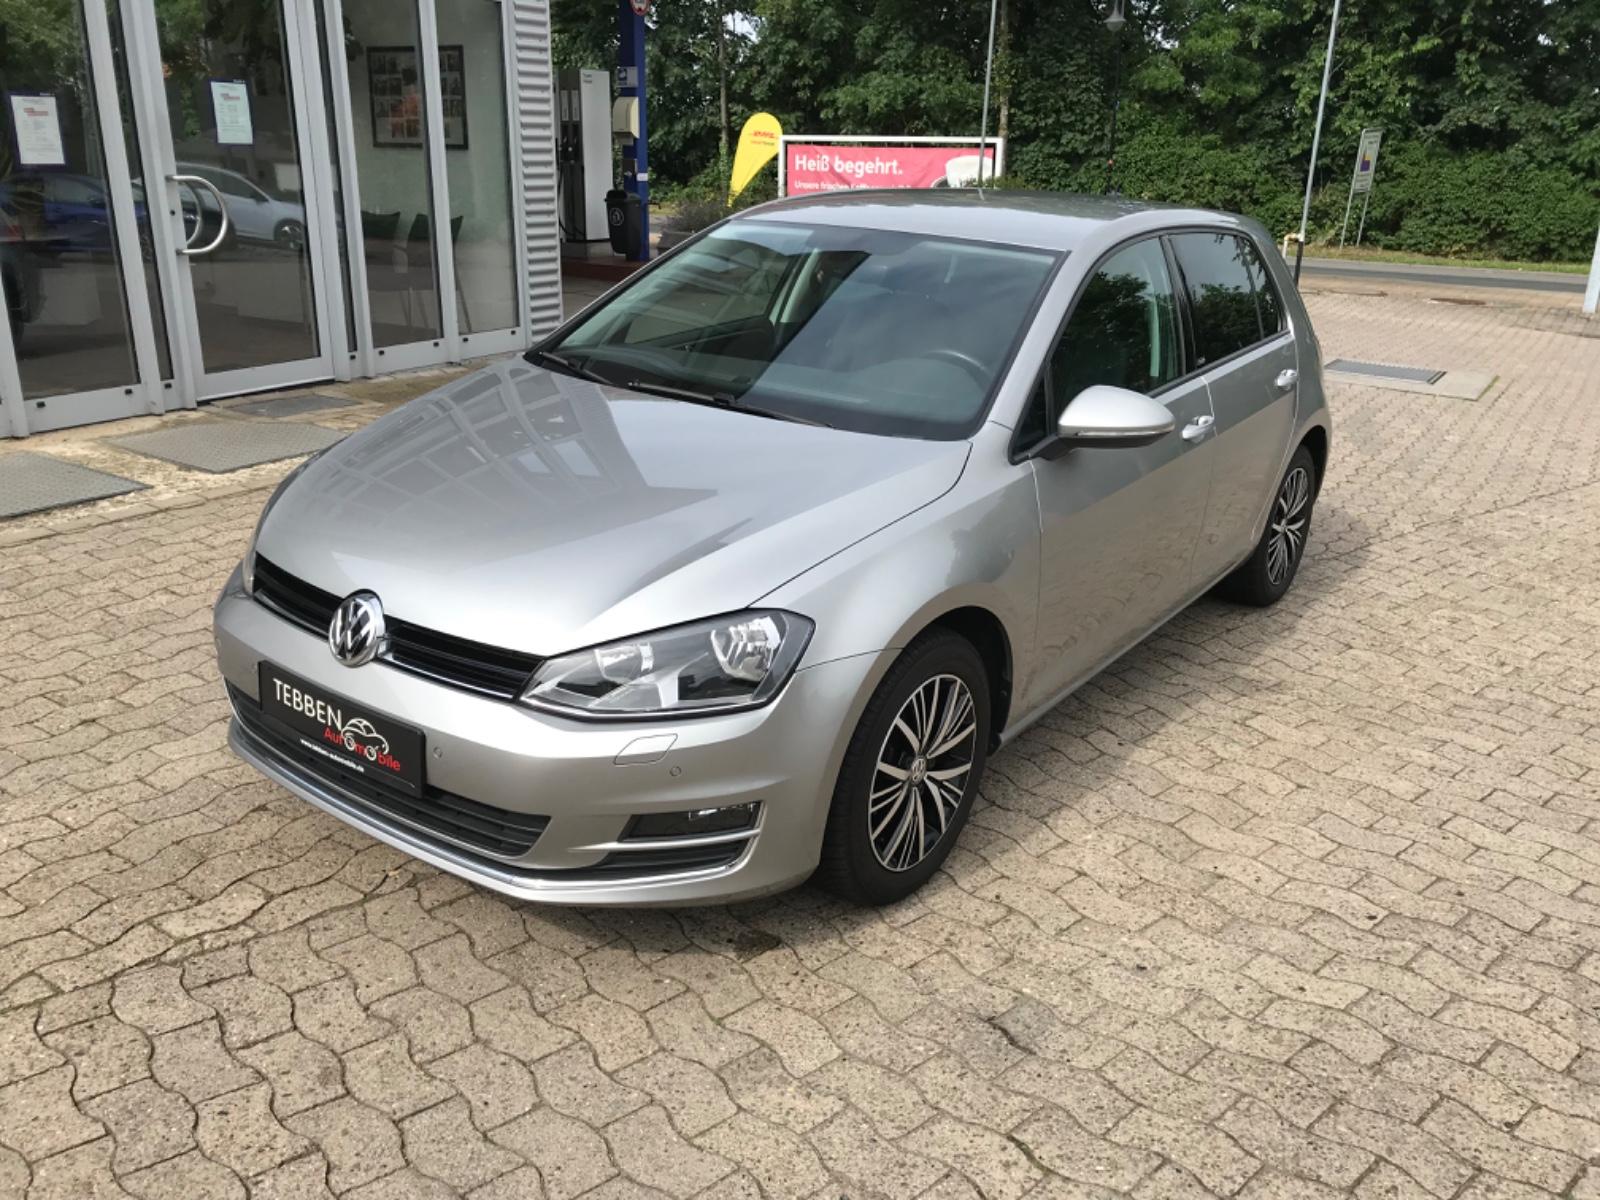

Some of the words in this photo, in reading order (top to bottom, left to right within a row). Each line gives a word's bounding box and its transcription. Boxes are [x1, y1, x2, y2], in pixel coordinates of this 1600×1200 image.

[794, 154, 830, 172] Heiß
[833, 156, 903, 178] begehrt.
[273, 677, 342, 731] TEBBEN
